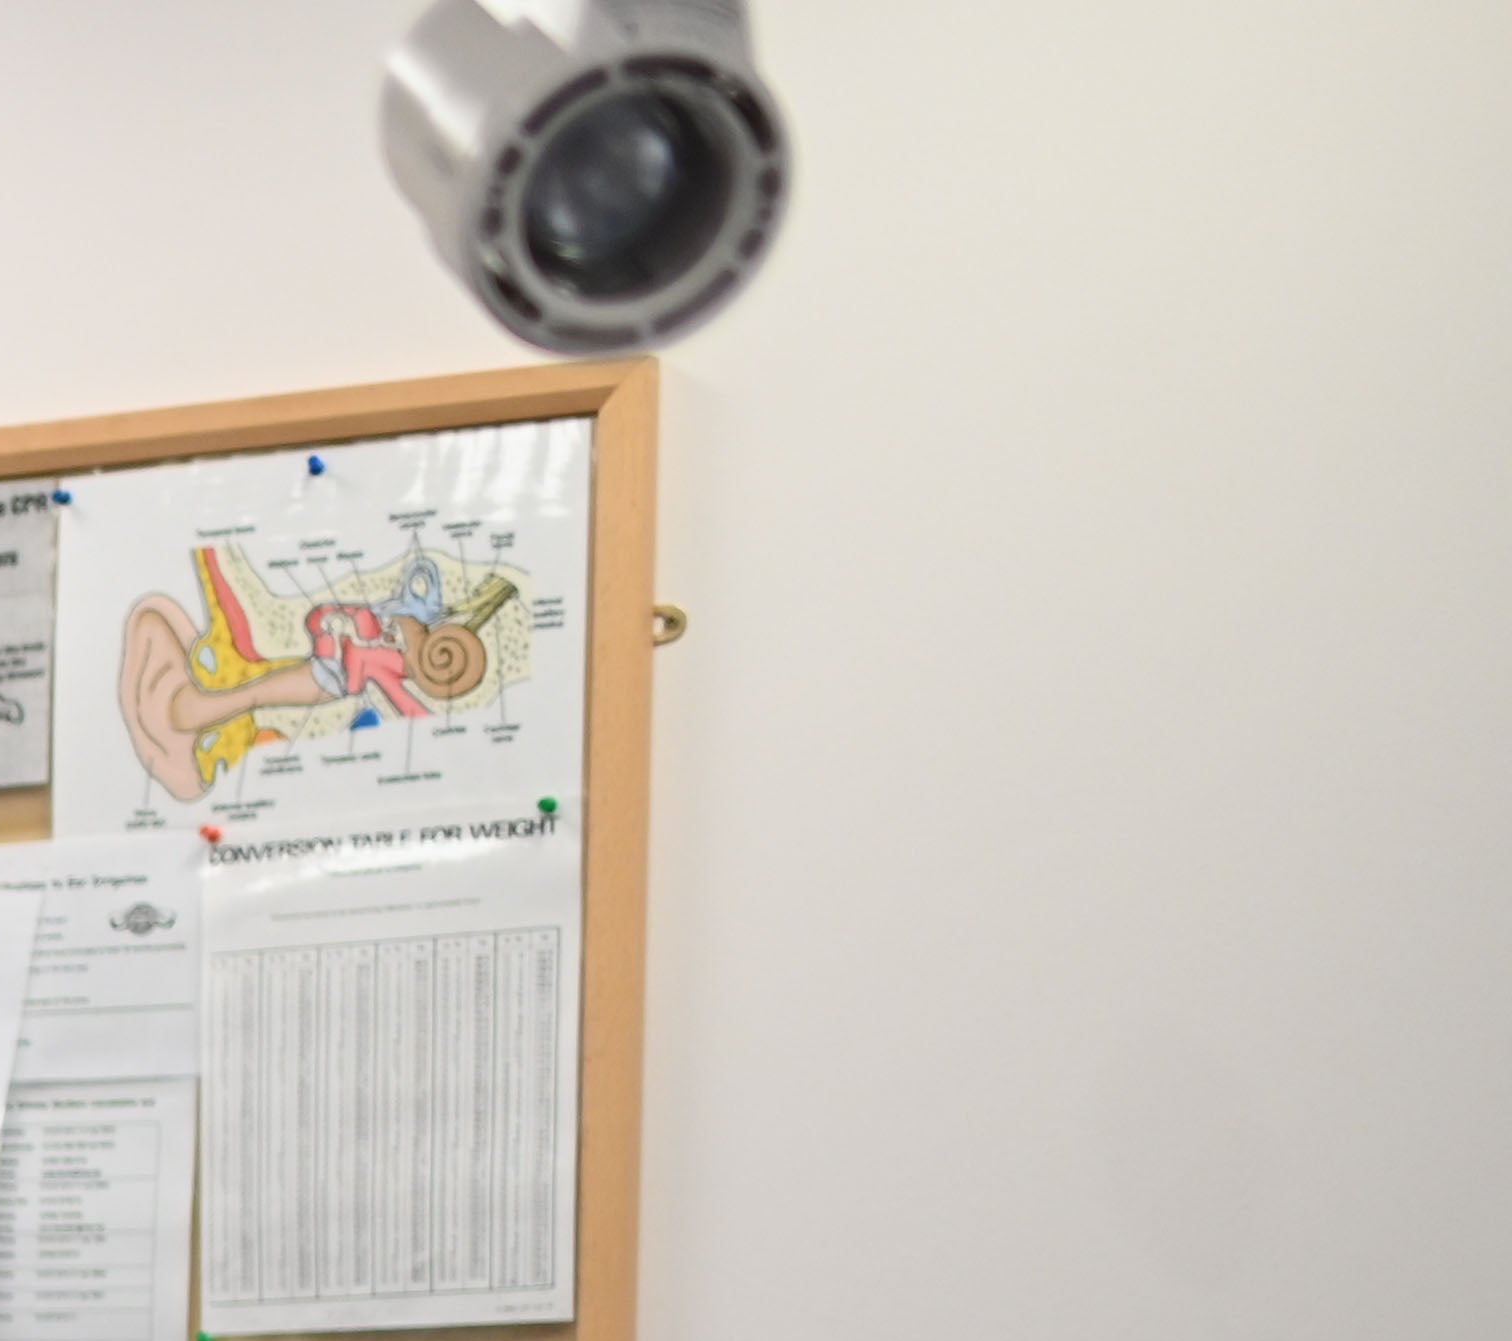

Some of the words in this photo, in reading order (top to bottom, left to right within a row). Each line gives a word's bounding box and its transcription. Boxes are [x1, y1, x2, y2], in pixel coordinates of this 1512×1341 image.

[11, 493, 49, 515] CPR
[209, 836, 342, 866] CONVERSION
[420, 825, 462, 845] FOR
[469, 815, 559, 842] WEIGHT
